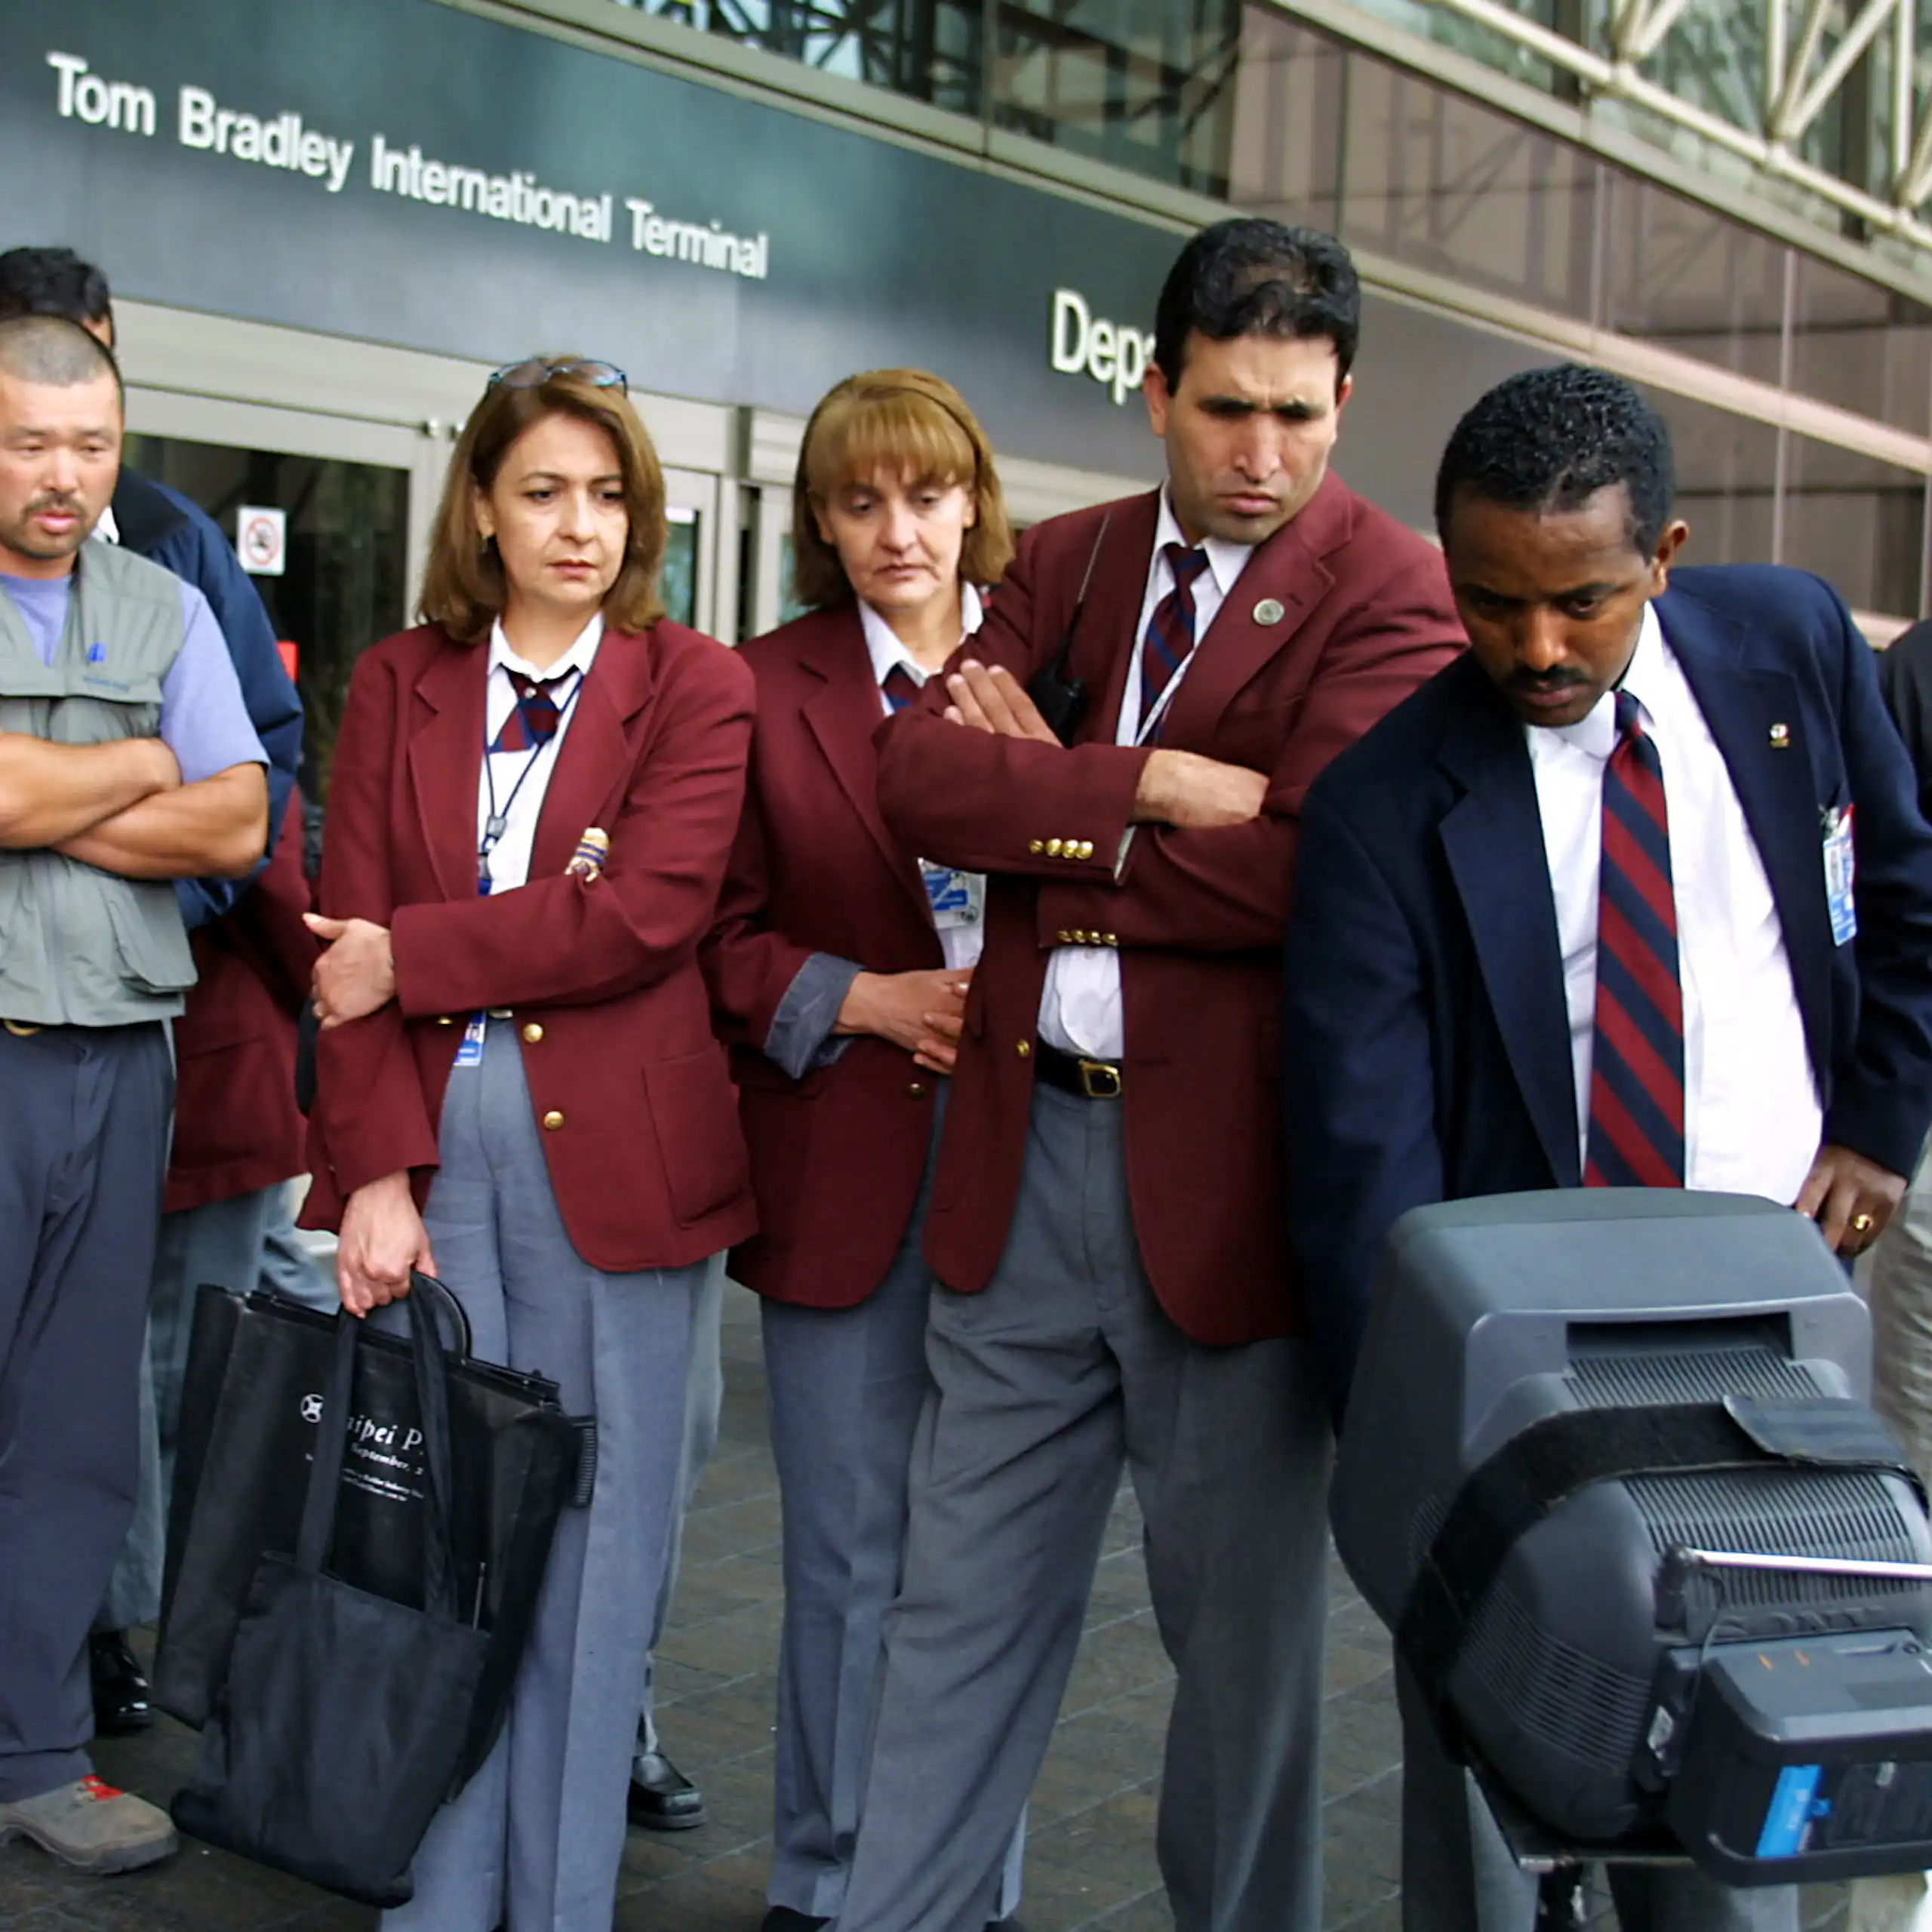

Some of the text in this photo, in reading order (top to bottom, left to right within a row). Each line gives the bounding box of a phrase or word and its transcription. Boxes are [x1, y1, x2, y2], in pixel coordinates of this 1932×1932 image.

[46, 51, 769, 279] Tom Bradley International Terminal
